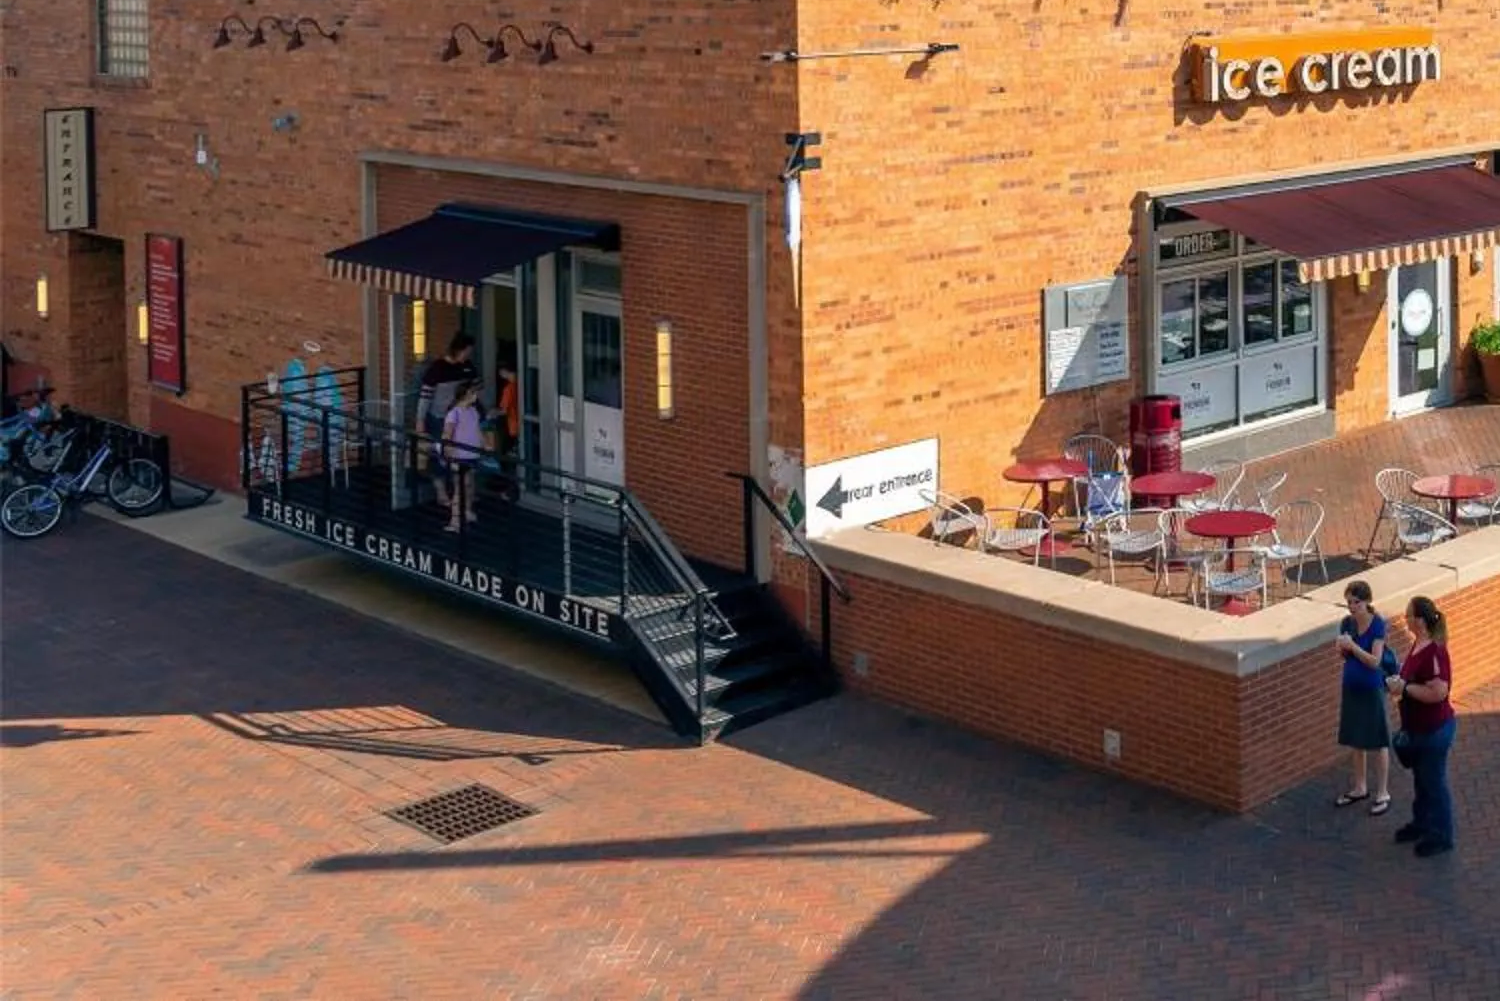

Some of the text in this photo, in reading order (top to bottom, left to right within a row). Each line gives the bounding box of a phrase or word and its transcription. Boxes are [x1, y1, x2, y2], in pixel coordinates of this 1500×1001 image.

[1209, 43, 1441, 101] ice cream
[60, 114, 73, 225] ENTRANCE
[1175, 232, 1214, 256] ORDER
[849, 483, 875, 501] rear
[262, 498, 609, 636] FRESH ICE CREAM MADE ON SITE
